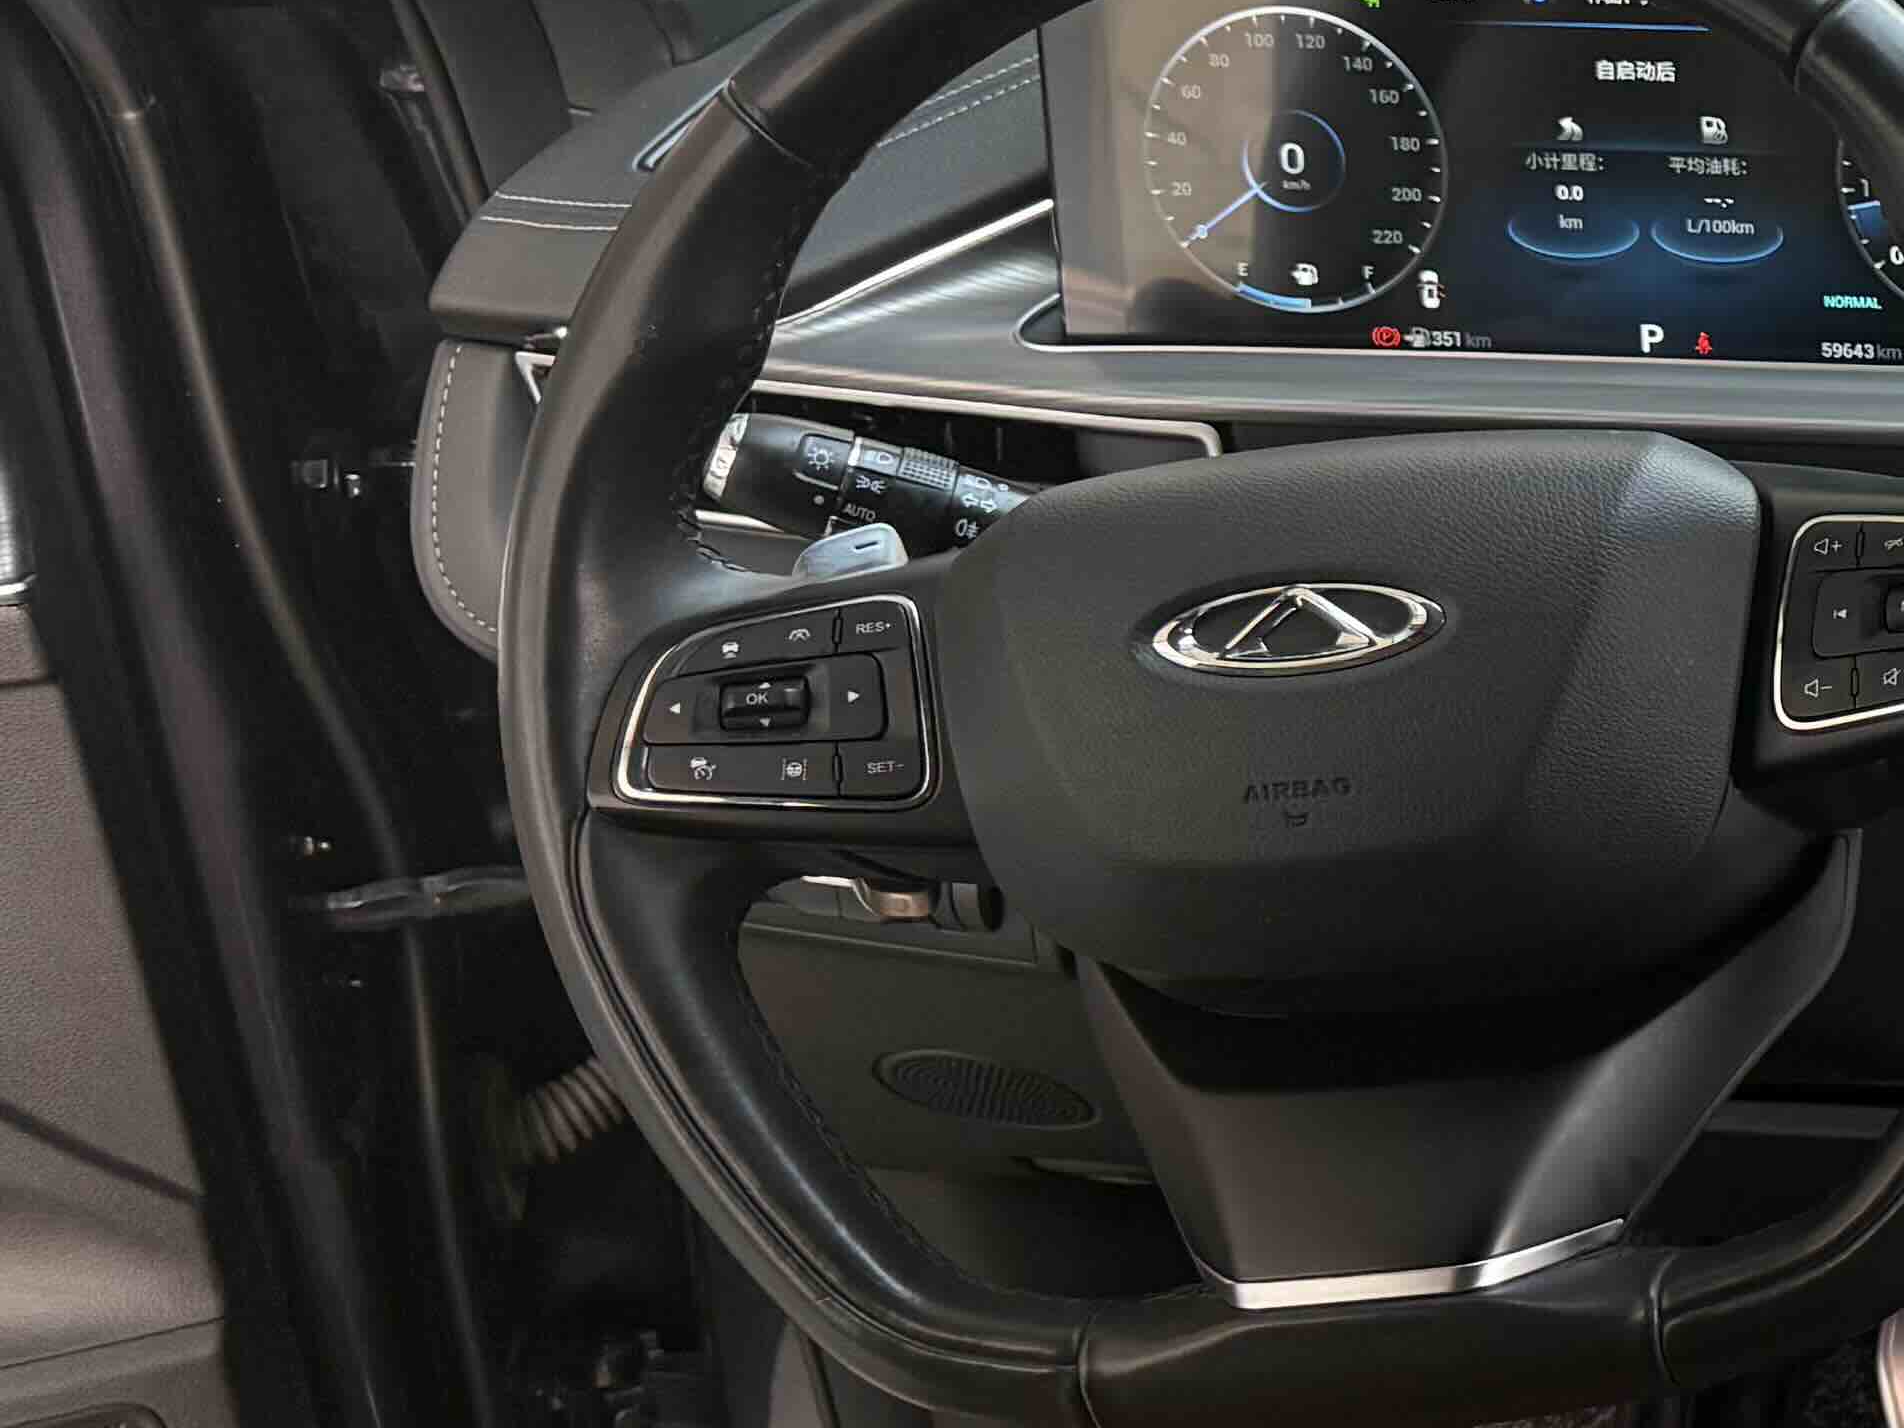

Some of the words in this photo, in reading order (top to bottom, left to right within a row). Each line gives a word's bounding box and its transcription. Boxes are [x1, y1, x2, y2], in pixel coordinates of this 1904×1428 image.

[1245, 32, 1274, 47] 100
[1296, 33, 1326, 50] 120
[1208, 53, 1230, 68] 80
[1343, 55, 1373, 72] 140
[1595, 60, 1676, 83] 自启动后
[1180, 85, 1202, 100] 60
[1368, 88, 1400, 105] 160
[1166, 132, 1188, 147] 40
[1390, 137, 1421, 153] 180
[1280, 142, 1306, 175] 0
[1171, 182, 1193, 197] 20
[1391, 188, 1422, 203] 200
[1555, 184, 1585, 202] 0.0
[1559, 214, 1584, 231] km
[1686, 218, 1755, 236] L/100km
[1372, 229, 1403, 246] 220
[1889, 244, 1904, 266] 0
[1236, 262, 1249, 277] E
[1361, 265, 1374, 280] F
[1823, 294, 1883, 310] NORMAL
[1431, 329, 1462, 347] 351
[1464, 332, 1493, 348] km
[1639, 323, 1665, 353] P
[1820, 341, 1875, 360] 59643
[1876, 345, 1902, 360] km
[843, 501, 877, 523] AUTO
[745, 692, 769, 706] OK
[1243, 775, 1355, 805] AIRBAG
